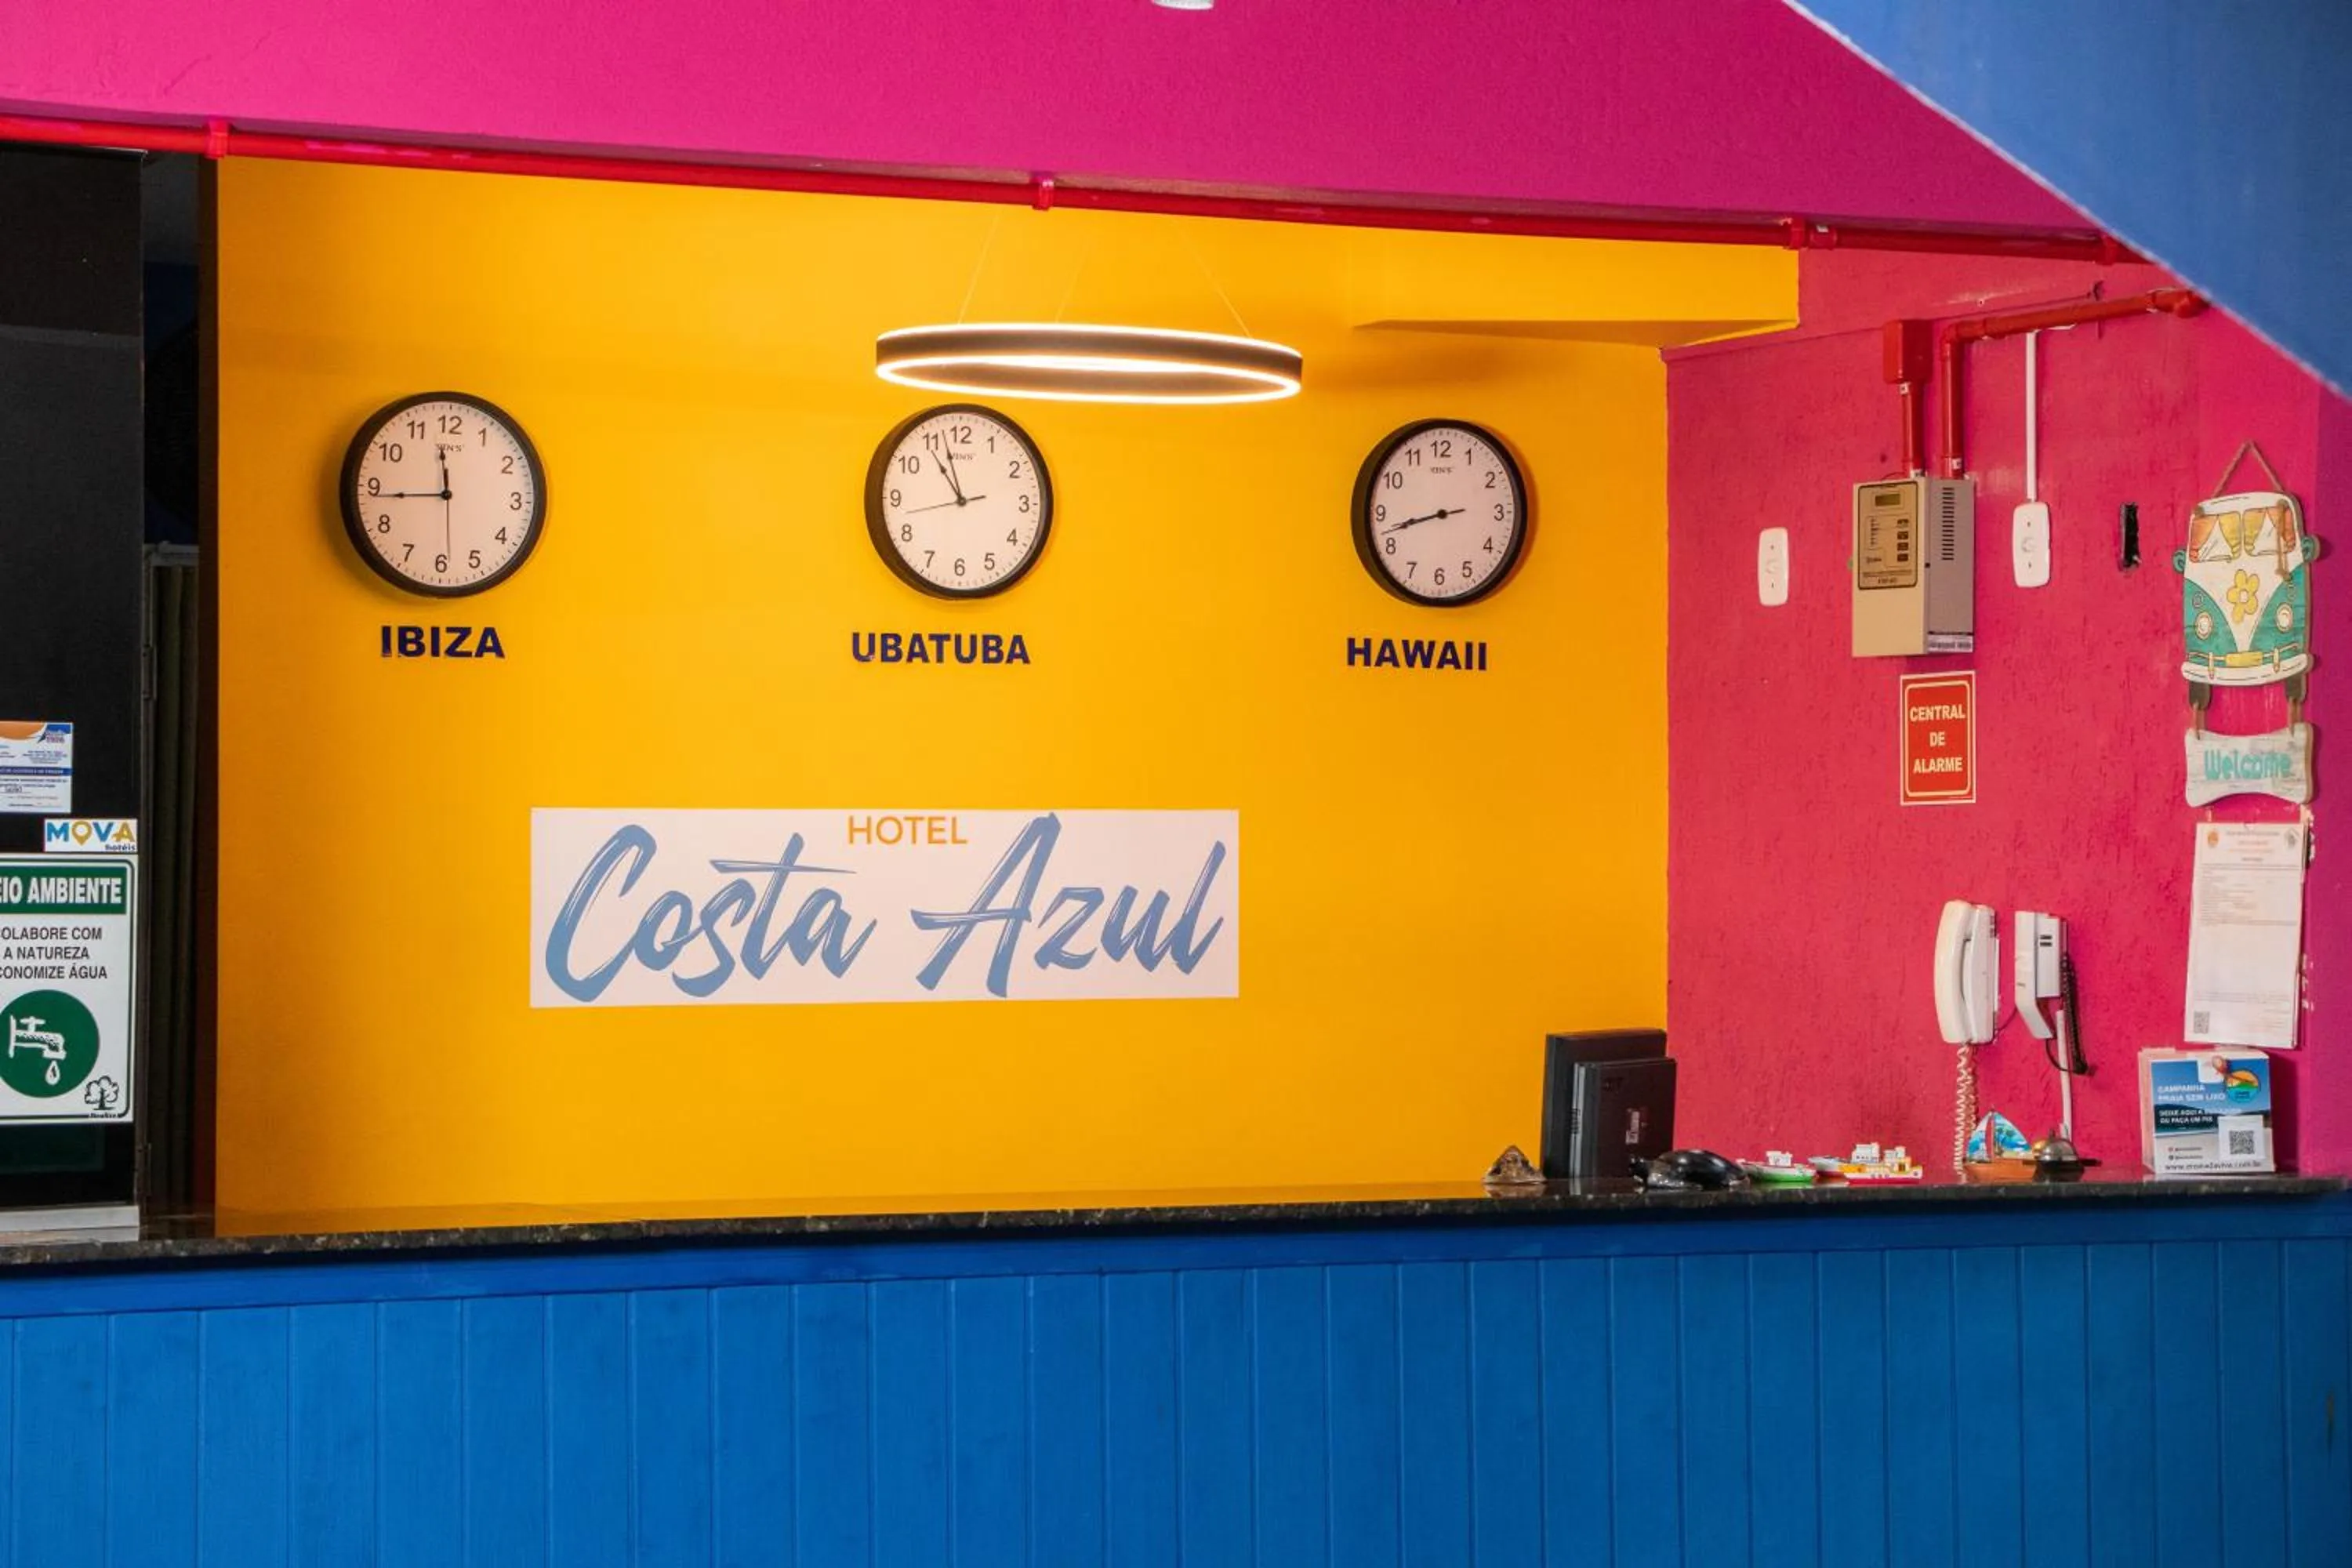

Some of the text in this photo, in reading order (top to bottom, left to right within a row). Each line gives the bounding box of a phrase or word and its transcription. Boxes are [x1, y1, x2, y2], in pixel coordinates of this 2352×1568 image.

[406, 419, 426, 440] 11
[437, 414, 463, 435] 12
[477, 427, 487, 447] 1
[922, 432, 938, 451] 11
[949, 425, 972, 445] 12
[987, 435, 995, 454] 1
[379, 442, 403, 463] 10
[1404, 448, 1421, 466] 11
[1430, 440, 1451, 458] 12
[1465, 448, 1472, 466] 1
[501, 455, 514, 475] 2
[898, 455, 920, 474] 10
[1009, 460, 1021, 479] 2
[367, 477, 382, 498] 9
[1381, 470, 1403, 490] 10
[1485, 471, 1496, 489] 2
[510, 492, 523, 511] 3
[890, 488, 902, 508] 9
[1018, 494, 1030, 514] 3
[1374, 504, 1387, 522] 9
[1494, 503, 1504, 521] 3
[377, 514, 391, 534] 8
[901, 524, 913, 543] 8
[495, 526, 507, 545] 4
[1006, 528, 1018, 546] 4
[1483, 536, 1494, 554] 4
[402, 543, 415, 563] 7
[1385, 537, 1396, 555] 8
[434, 554, 448, 573] 6
[468, 550, 481, 569] 5
[924, 550, 935, 568] 7
[954, 557, 966, 577] 6
[984, 552, 996, 571] 5
[1406, 561, 1417, 579] 7
[1434, 567, 1445, 586] 6
[1461, 561, 1473, 579] 5
[381, 626, 505, 659] IBIZA
[852, 632, 1031, 665] UBATUBA
[1347, 637, 1487, 671] HAWAII
[1909, 704, 1966, 722] CENTRAL
[1929, 731, 1946, 747] DE
[1913, 757, 1963, 774] ALARME
[2204, 750, 2296, 780] Welcome
[47, 821, 135, 846] MOVA
[848, 815, 968, 845] HOTEL
[0, 876, 122, 904] IO AMBIENTE
[545, 812, 1225, 1003] Costa Azul
[71, 927, 103, 940] COM
[3, 946, 89, 960] A NATUREZA
[0, 963, 107, 979] ONOMIZE ÁGUA
